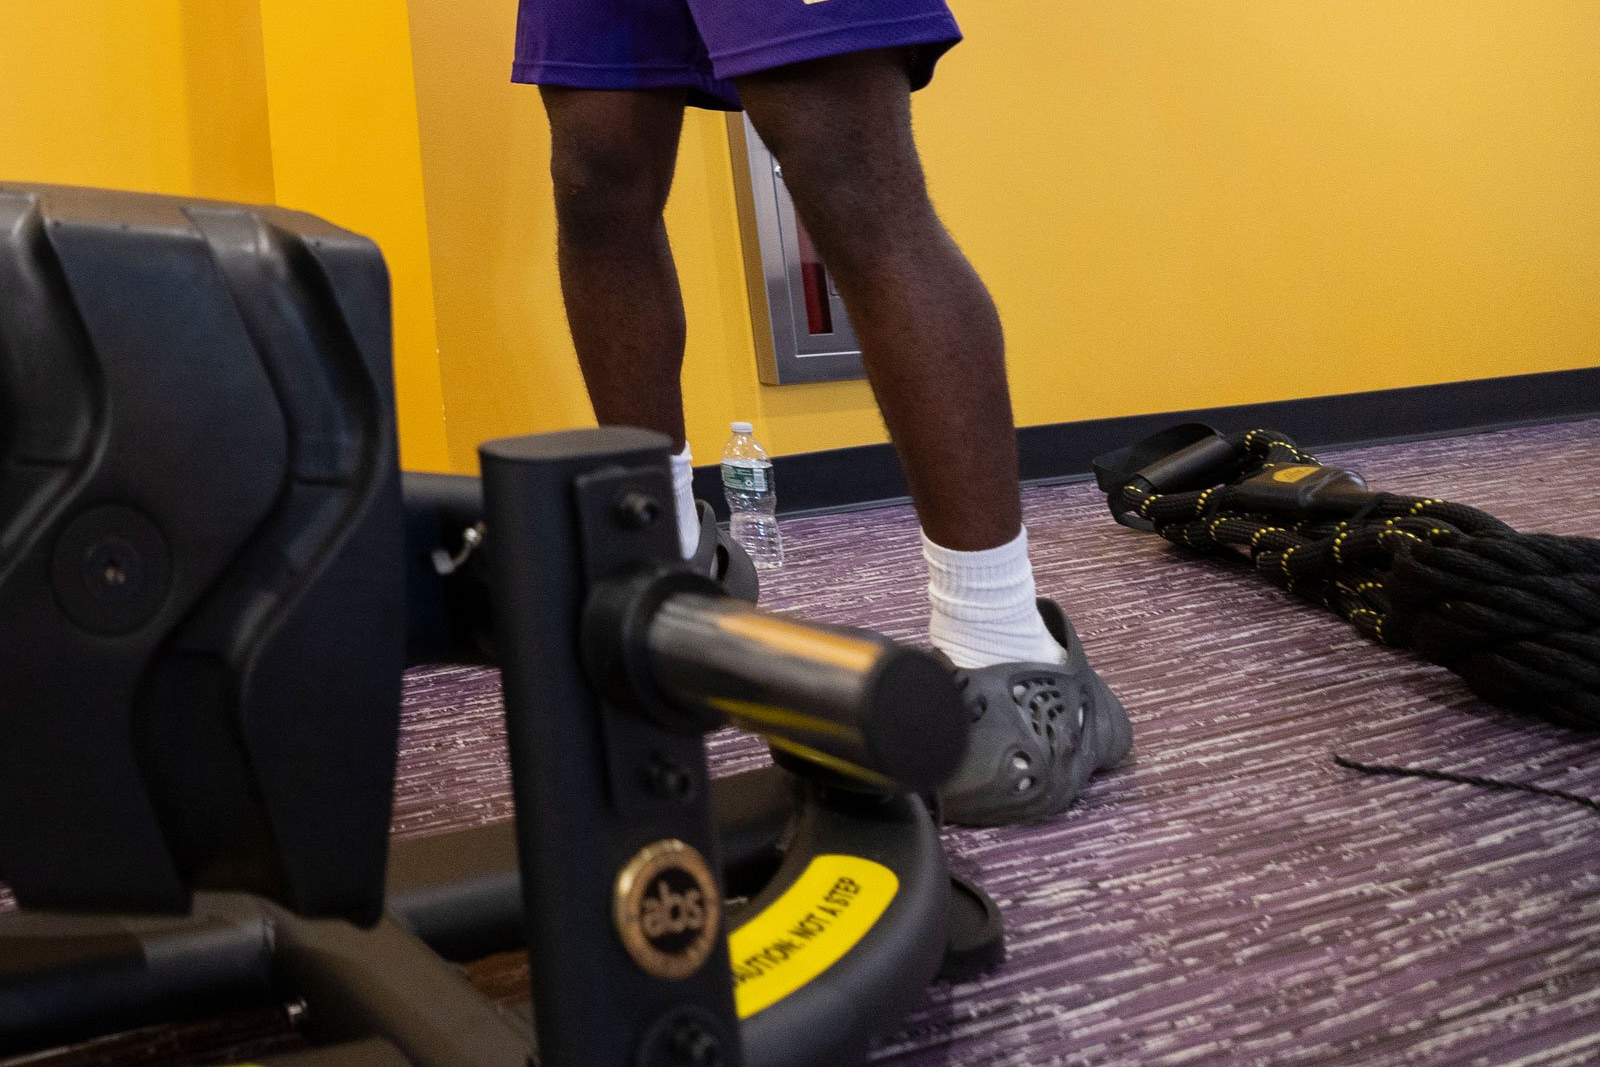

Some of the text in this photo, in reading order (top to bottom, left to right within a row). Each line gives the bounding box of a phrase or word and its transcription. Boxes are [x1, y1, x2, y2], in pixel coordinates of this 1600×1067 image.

[823, 876, 862, 908] STEP
[641, 880, 703, 938] abs
[816, 904, 844, 918] A
[787, 911, 833, 942] NOT
